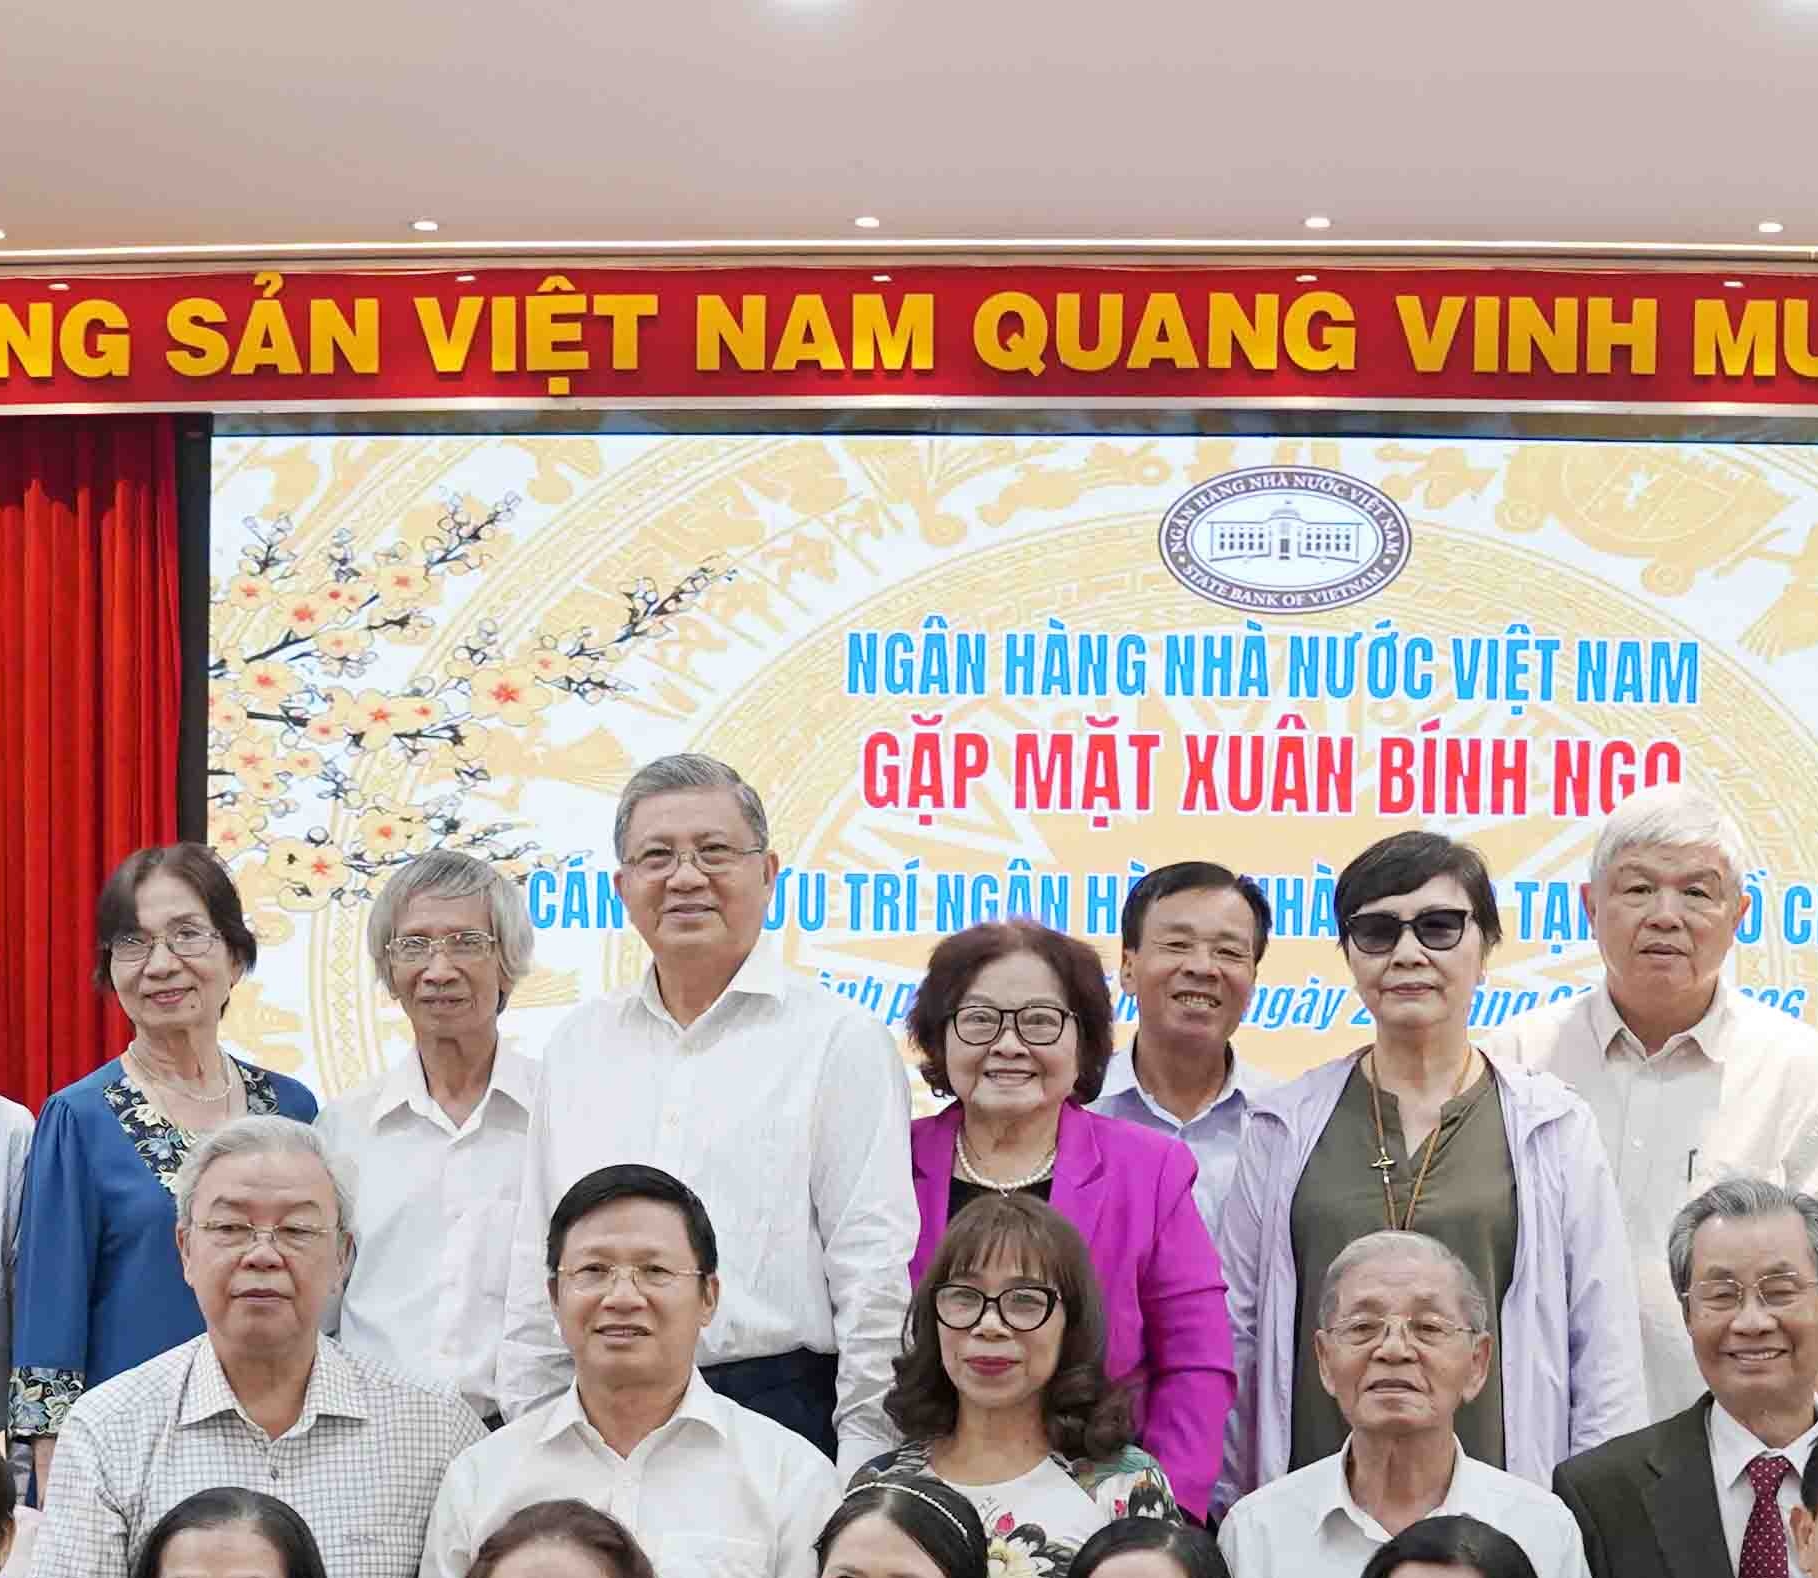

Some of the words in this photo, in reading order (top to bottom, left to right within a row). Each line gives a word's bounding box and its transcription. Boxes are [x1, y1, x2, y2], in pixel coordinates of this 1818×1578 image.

[166, 270, 381, 376] SẢN
[415, 276, 656, 395] VIỆT
[696, 294, 933, 372] NAM
[974, 291, 1356, 377] QUANG
[1396, 295, 1657, 377] VINH
[1381, 513, 1401, 556] NAM
[1183, 565, 1228, 597] STATE
[1230, 589, 1282, 606] BANK
[1282, 591, 1306, 607] OF
[1306, 567, 1386, 604] VIETNAM
[848, 616, 986, 694] NGÂN
[1004, 617, 1147, 697] HÀNG
[1164, 619, 1268, 697] NHÀ
[1288, 619, 1434, 700] NƯỚC
[1451, 623, 1560, 716] VIỆT
[1576, 640, 1699, 704] NAM
[863, 714, 989, 826] GẶP
[1015, 716, 1160, 828] MẶT
[1184, 713, 1354, 812] XUÂN
[1379, 718, 1527, 815] BÍNH
[529, 856, 623, 929] CÁN
[763, 867, 826, 932] ƯU
[843, 858, 920, 932] TRÍ
[936, 858, 1069, 933] NGÂN
[1257, 863, 1340, 936] HÀ
[1736, 869, 1766, 944] Ồ
